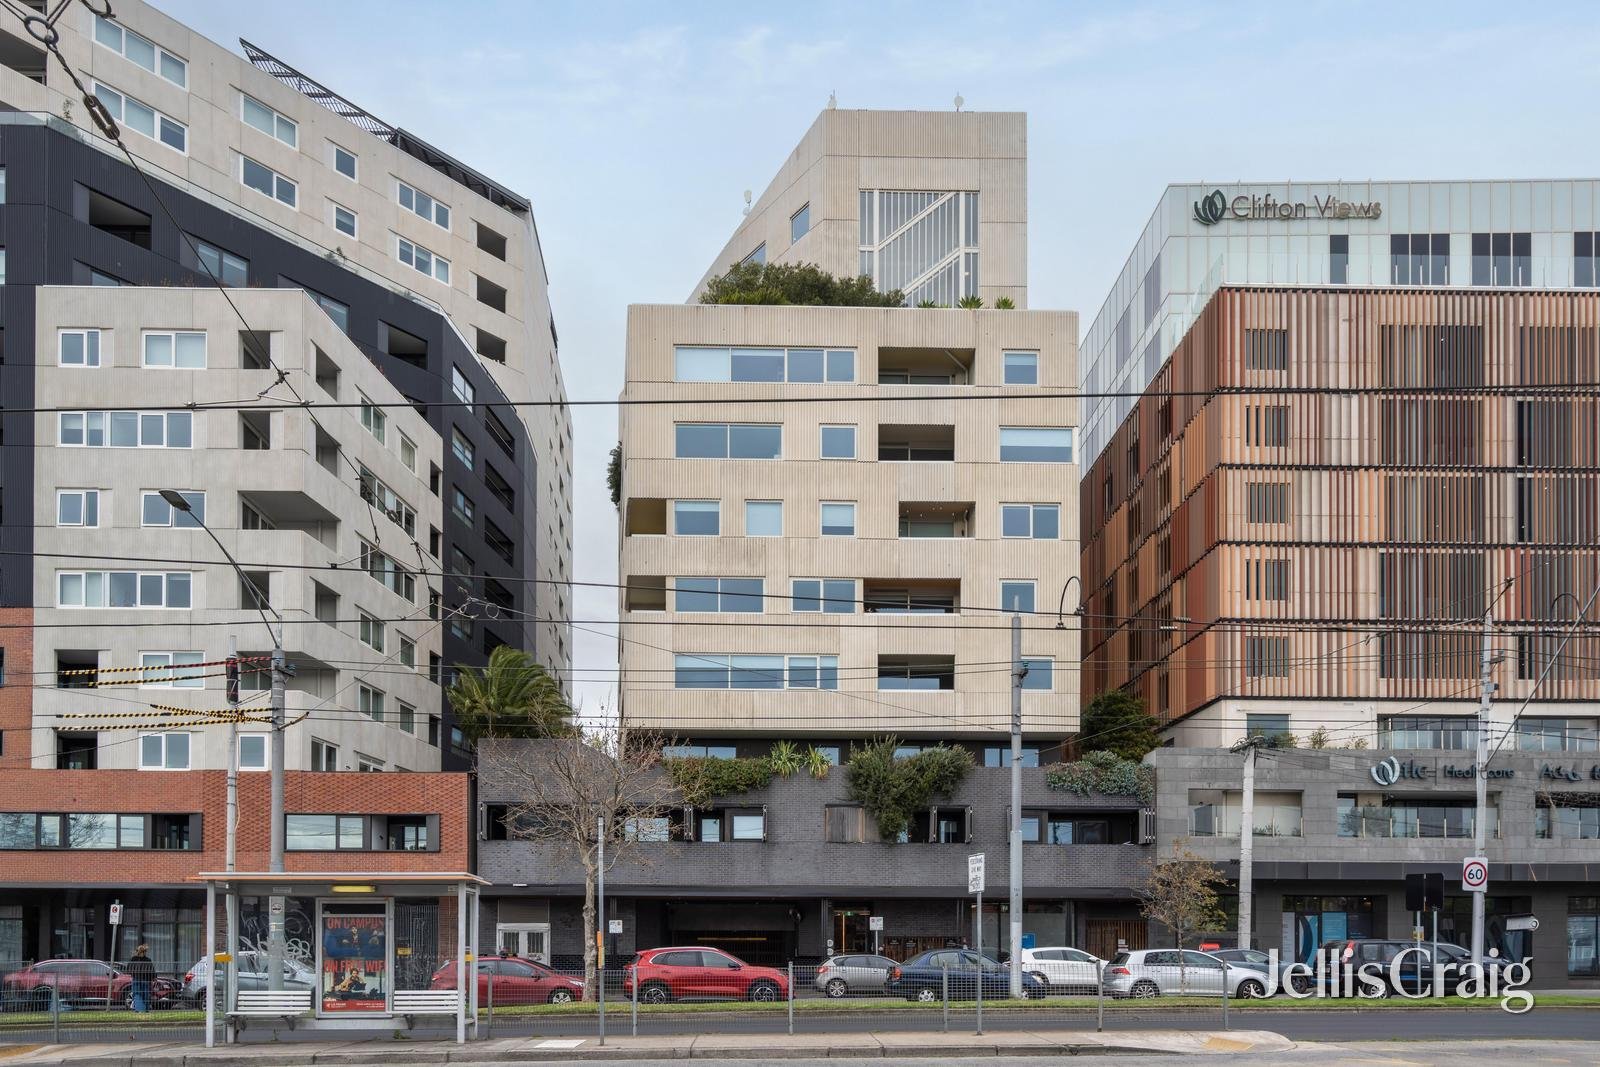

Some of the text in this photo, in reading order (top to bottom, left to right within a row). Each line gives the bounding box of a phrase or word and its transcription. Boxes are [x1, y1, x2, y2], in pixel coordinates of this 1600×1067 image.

[1231, 193, 1383, 220] Clifton Views
[1443, 764, 1515, 780] Healcare
[1468, 868, 1483, 880] 60
